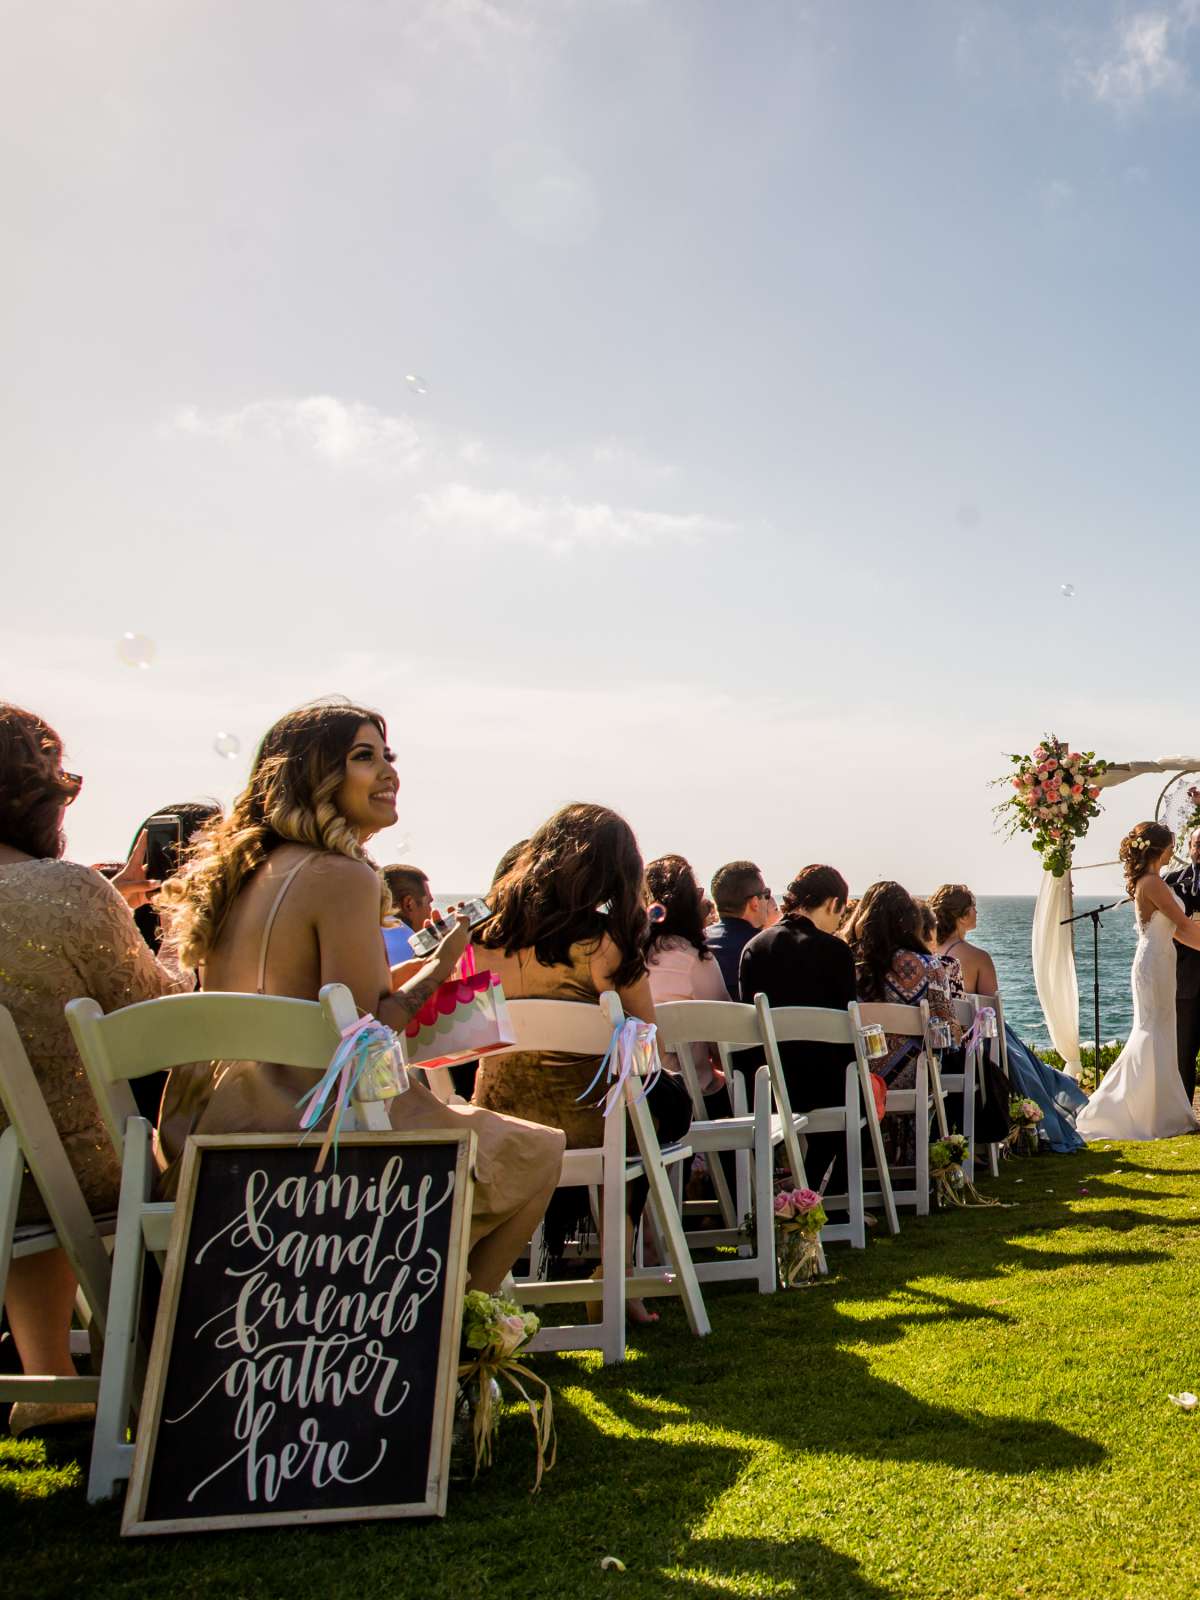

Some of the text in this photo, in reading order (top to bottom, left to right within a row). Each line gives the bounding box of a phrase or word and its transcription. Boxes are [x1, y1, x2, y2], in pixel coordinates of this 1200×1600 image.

[195, 1156, 456, 1265] family
[225, 1215, 396, 1286] and
[195, 1248, 442, 1354] friends
[165, 1333, 410, 1440] gather
[188, 1402, 387, 1502] here
